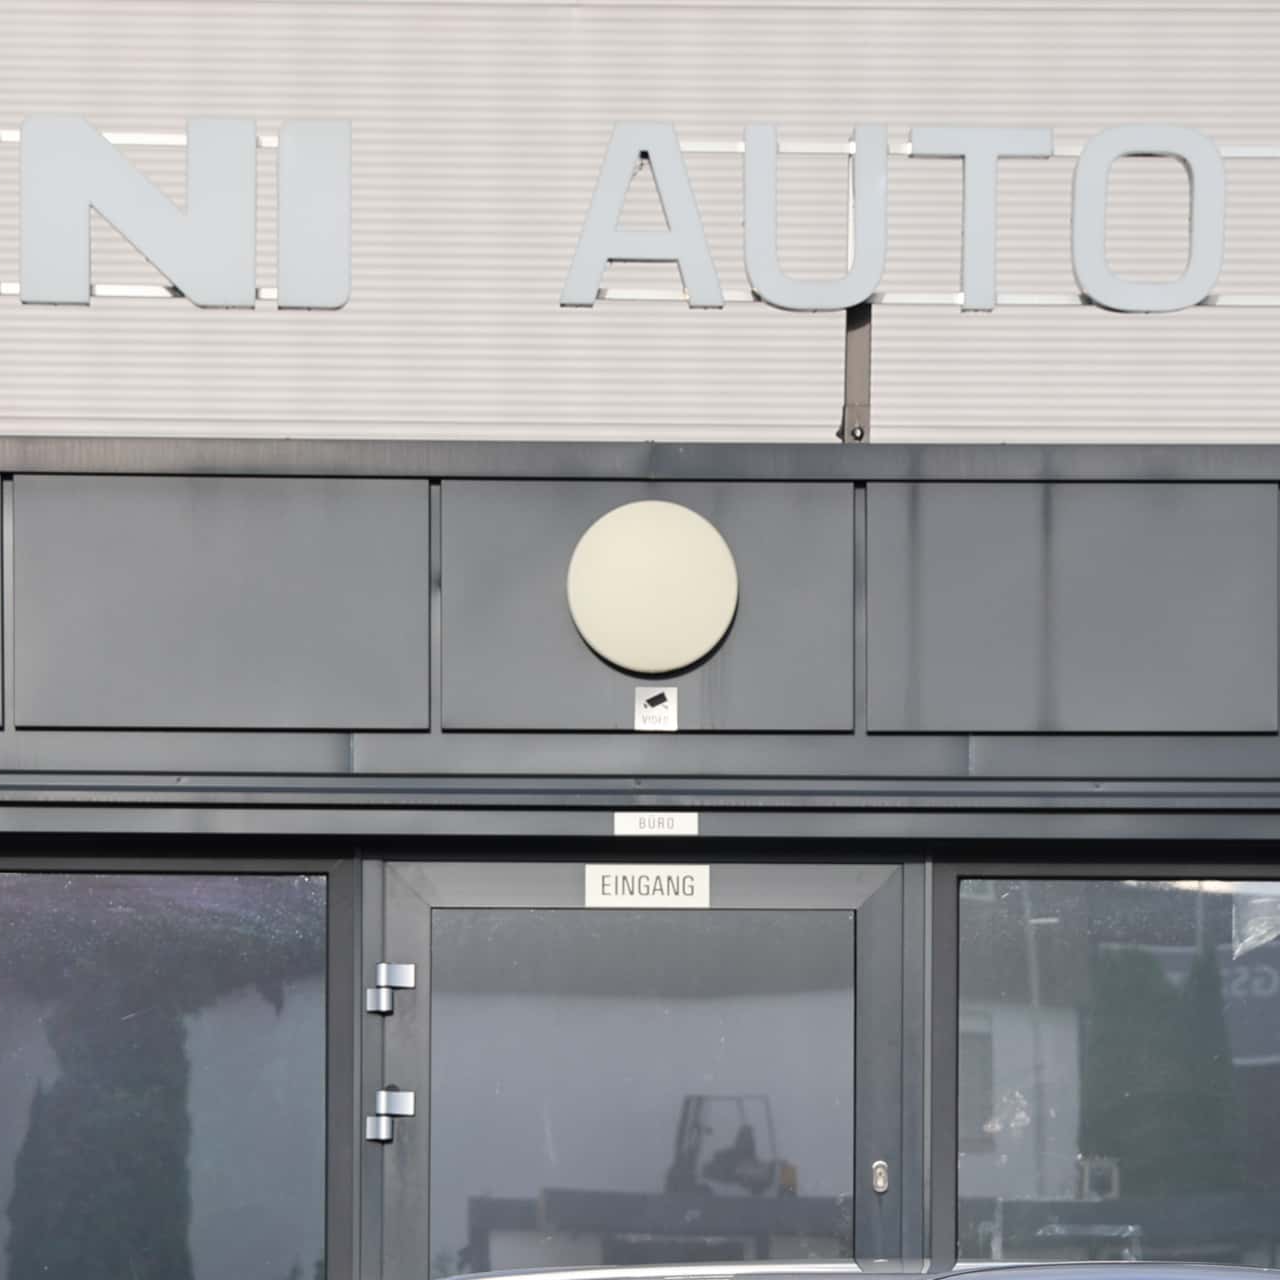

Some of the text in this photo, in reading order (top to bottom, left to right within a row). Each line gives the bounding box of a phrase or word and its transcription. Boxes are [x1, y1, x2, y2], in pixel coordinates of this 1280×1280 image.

[559, 120, 1221, 313] AUTO
[638, 815, 675, 830] BÜRO
[600, 874, 696, 897] EINGANG
